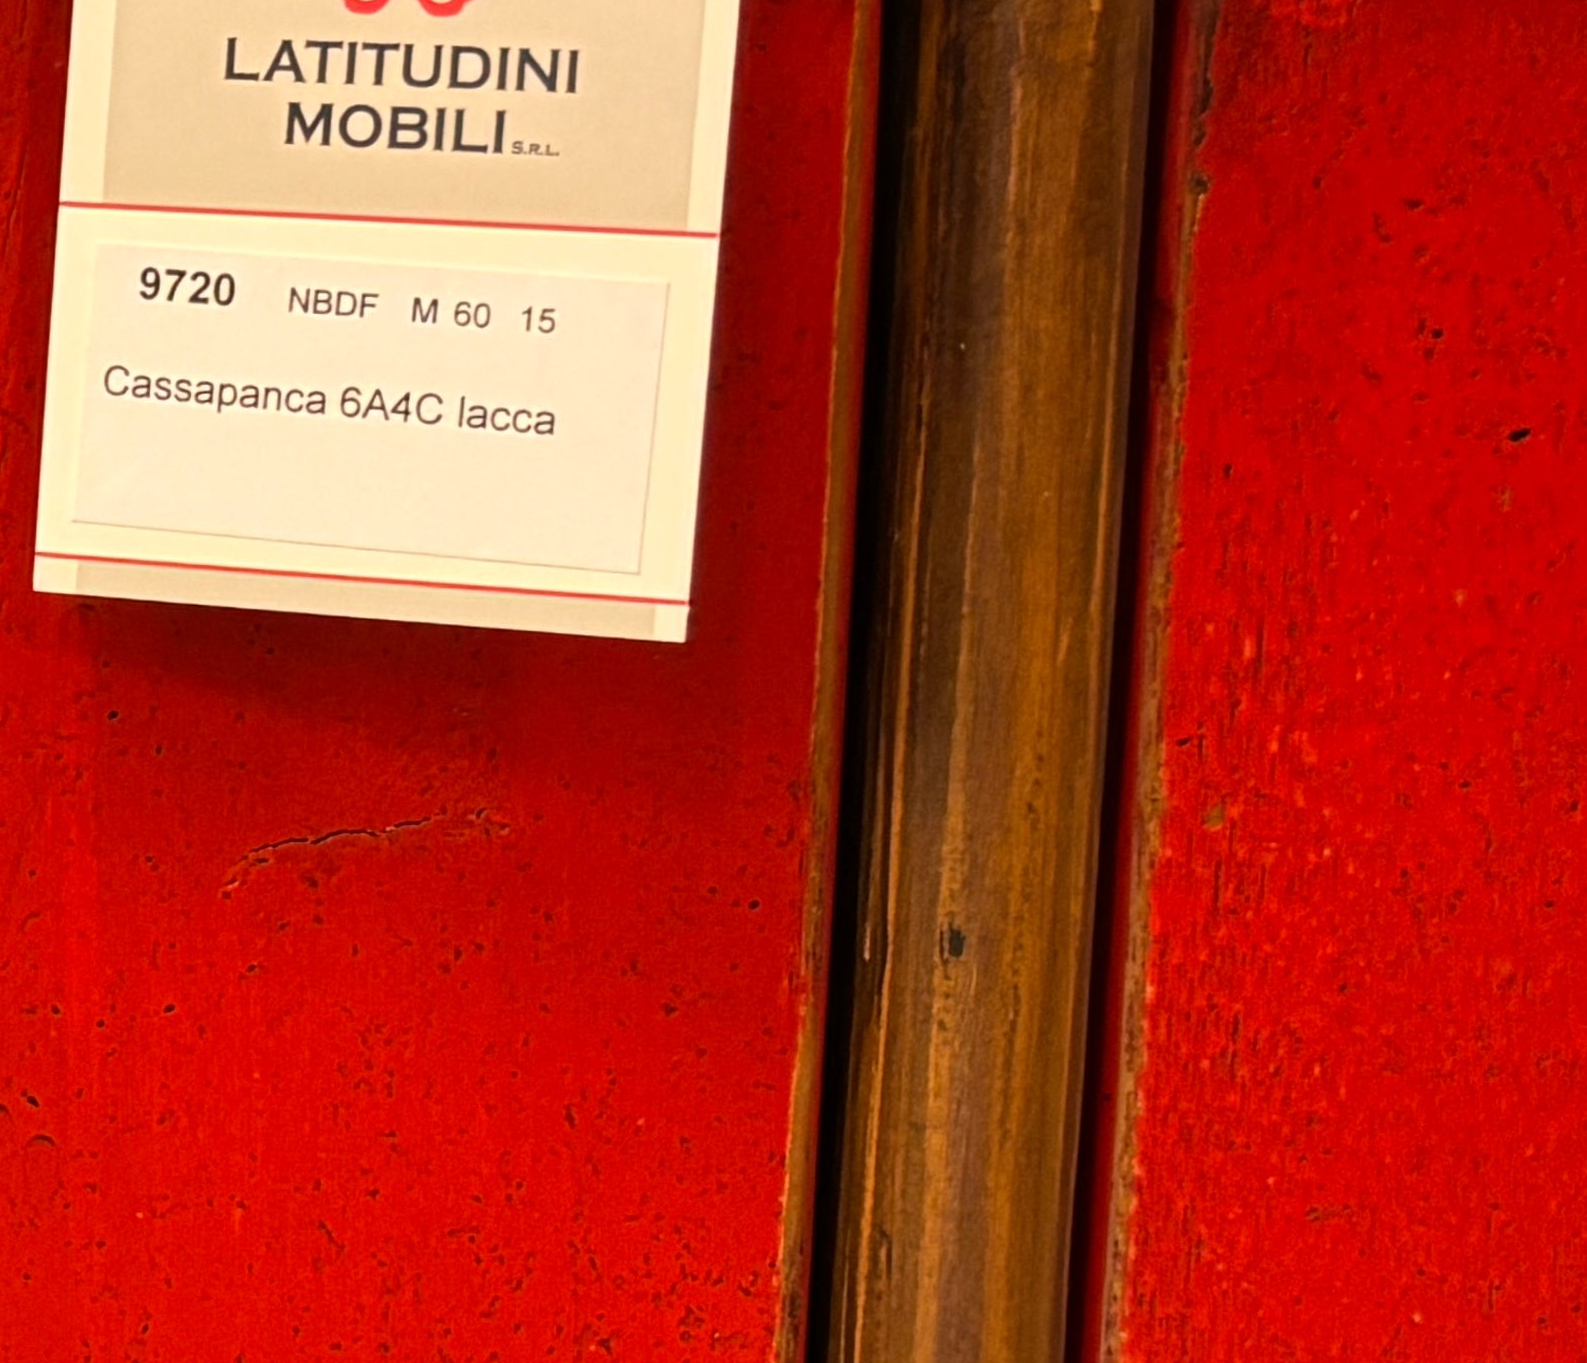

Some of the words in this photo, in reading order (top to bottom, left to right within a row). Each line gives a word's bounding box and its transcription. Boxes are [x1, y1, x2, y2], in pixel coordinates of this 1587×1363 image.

[224, 36, 580, 94] LATITUDINI
[284, 101, 507, 154] MOBILI
[511, 140, 560, 157] S.R.L.
[139, 266, 236, 307] 9720
[288, 287, 380, 318] NBDF
[411, 296, 439, 324] M
[453, 301, 491, 329] 60
[522, 306, 556, 334] 15
[103, 364, 327, 415] Cassapanca
[340, 386, 444, 425] 6A4C
[458, 395, 556, 435] lacca
